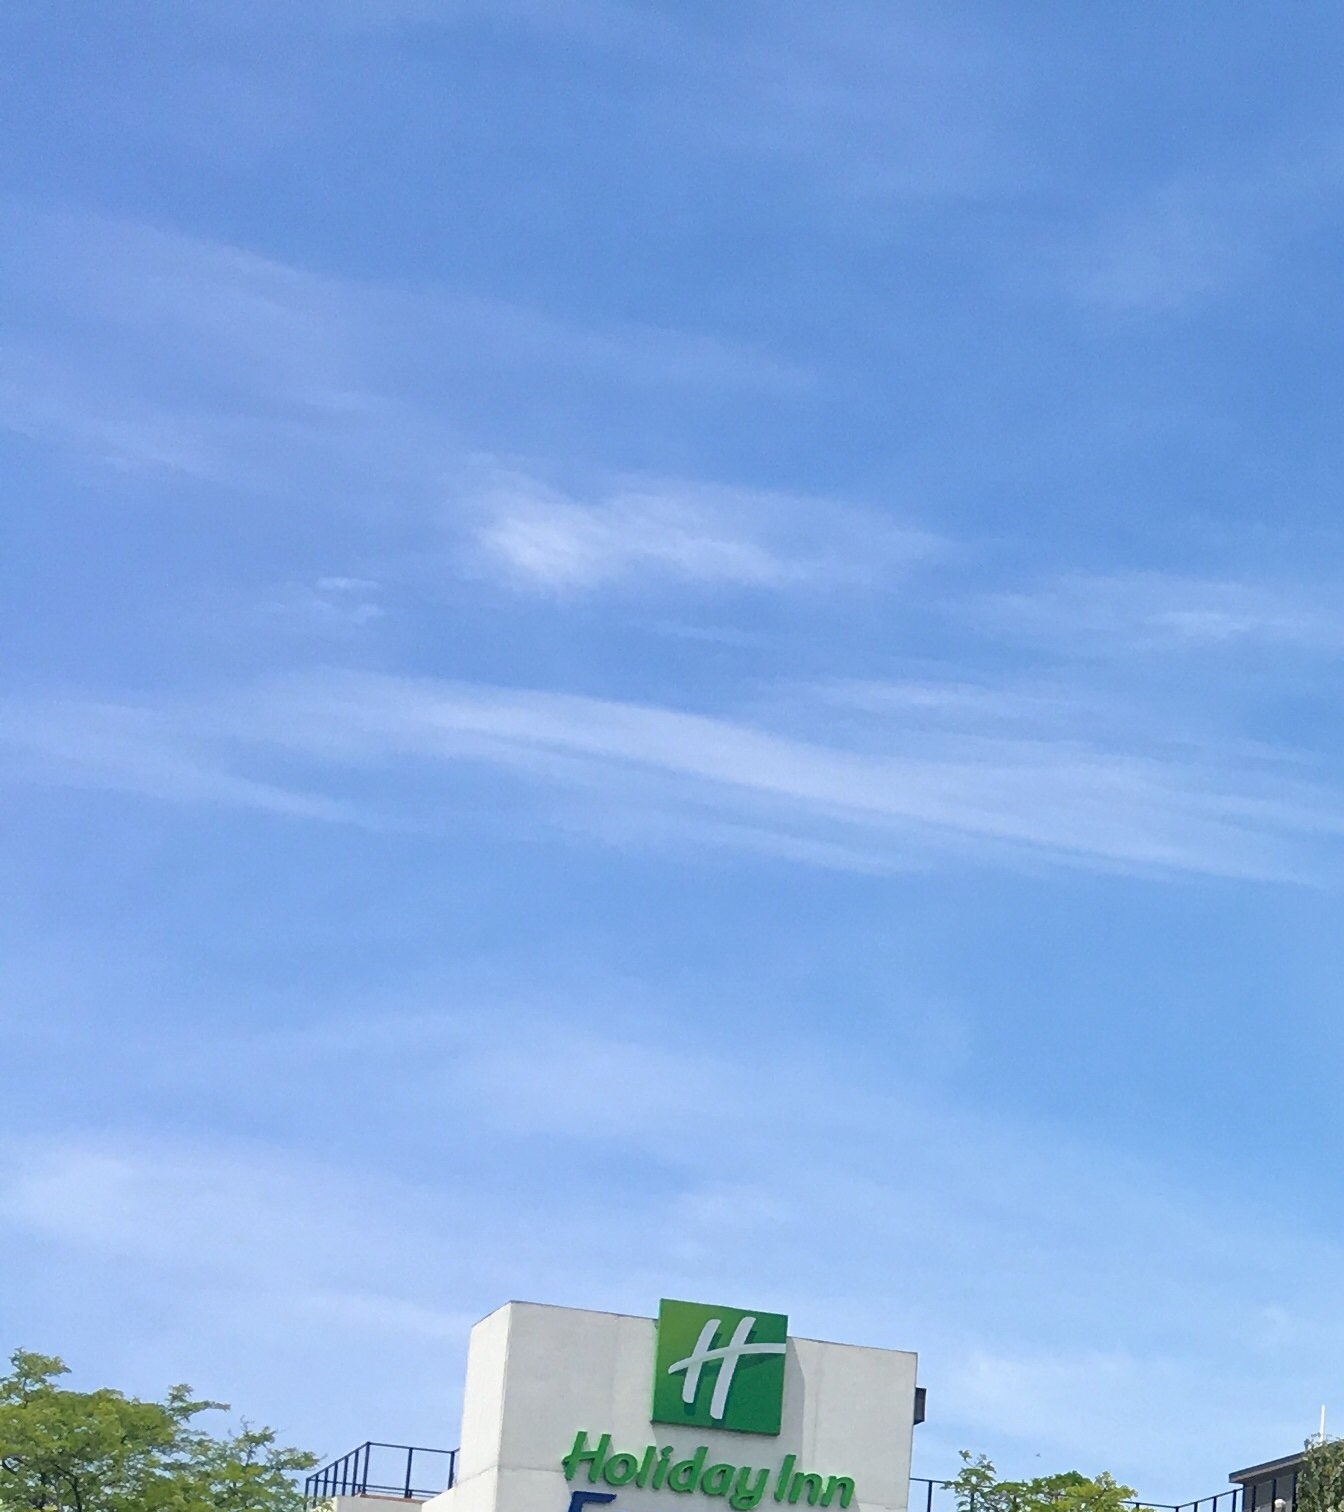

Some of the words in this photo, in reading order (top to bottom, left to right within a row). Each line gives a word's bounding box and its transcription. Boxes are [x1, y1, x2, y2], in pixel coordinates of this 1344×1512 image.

[667, 1316, 787, 1420] H
[562, 1430, 770, 1511] Holiday
[774, 1453, 855, 1509] Inn
